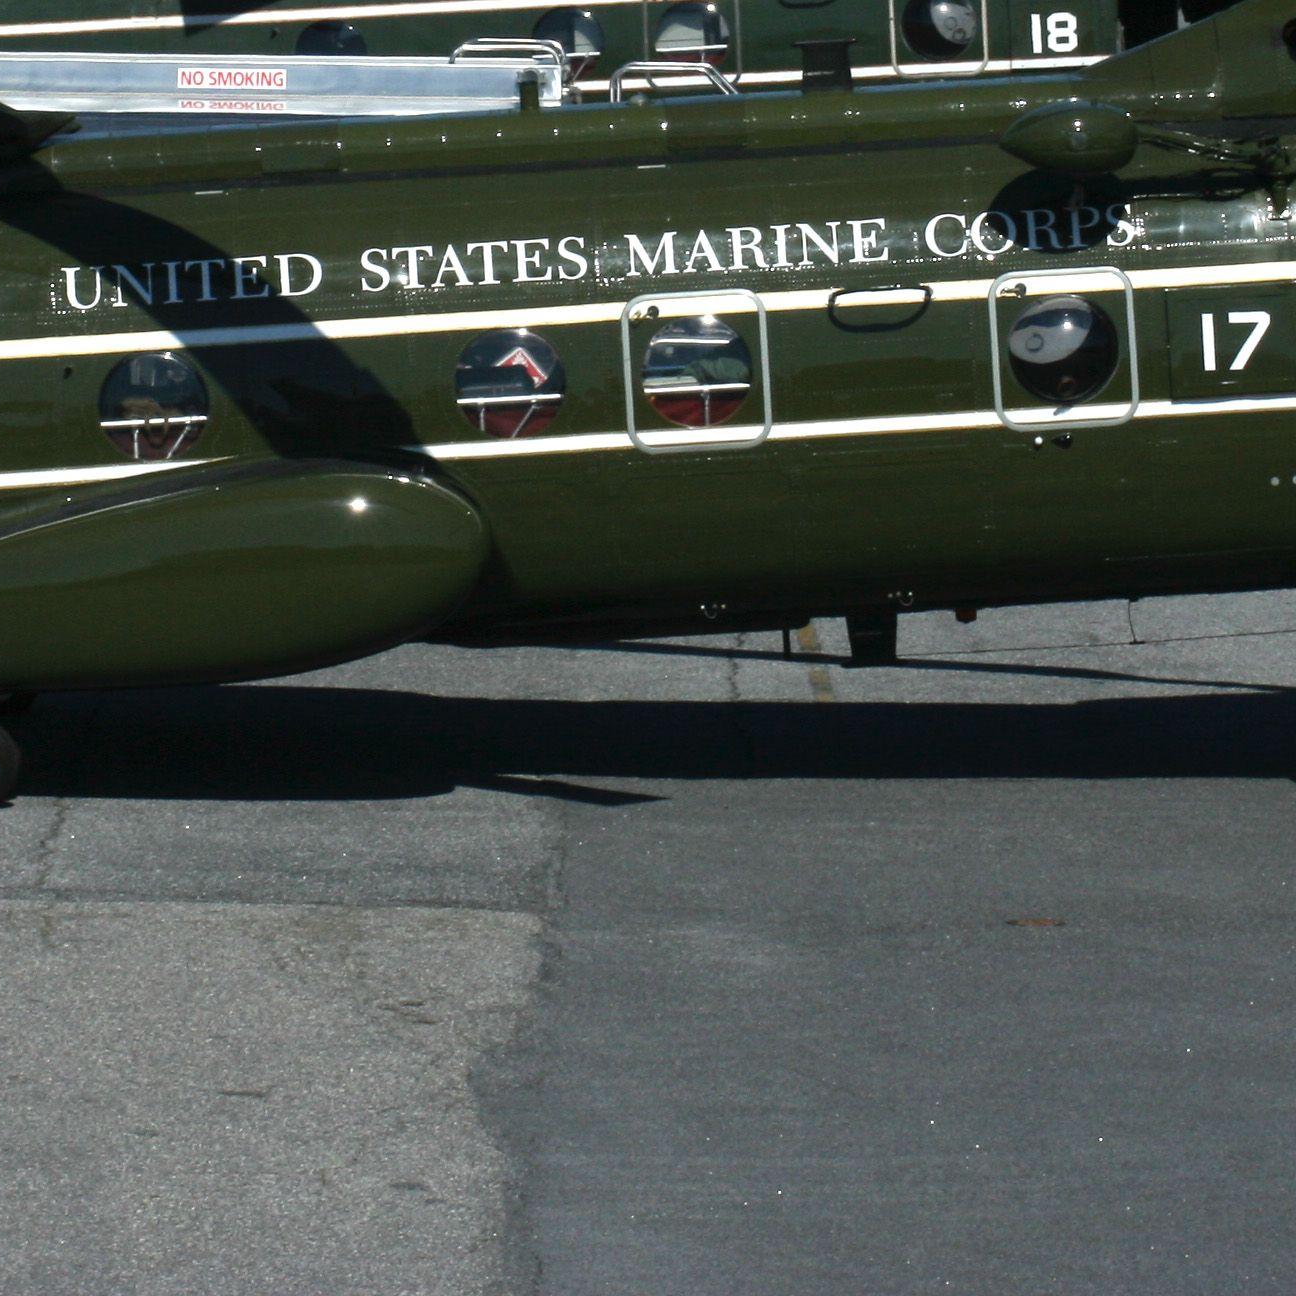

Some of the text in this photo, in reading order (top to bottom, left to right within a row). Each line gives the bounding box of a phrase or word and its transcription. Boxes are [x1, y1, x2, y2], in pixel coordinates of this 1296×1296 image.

[1030, 12, 1079, 54] 18
[180, 70, 284, 87] NO SMOKING
[60, 203, 1136, 310] UNITED STATES MARINE CORPS
[1201, 311, 1271, 371] 17
